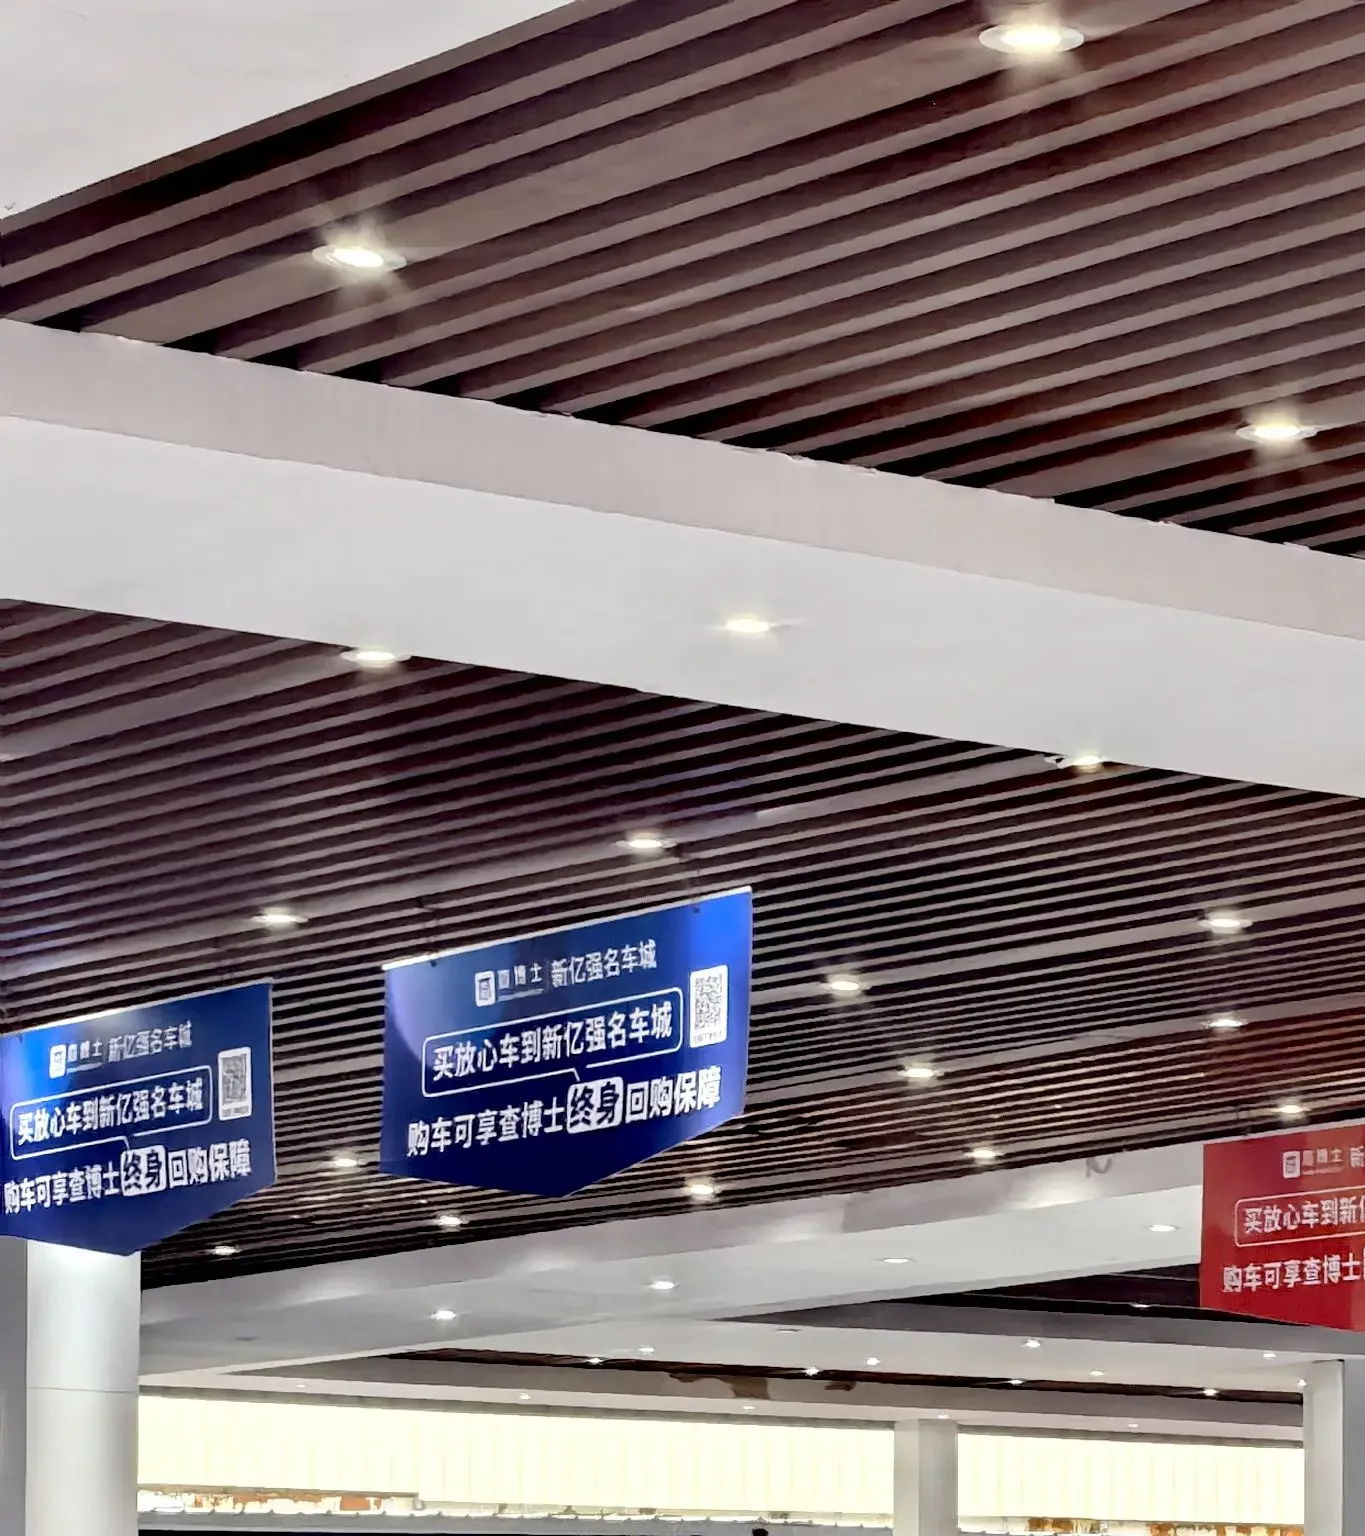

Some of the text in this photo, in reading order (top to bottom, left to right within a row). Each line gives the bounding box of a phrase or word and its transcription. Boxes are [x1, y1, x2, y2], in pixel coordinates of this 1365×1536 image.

[551, 939, 658, 988] 新亿强名车城
[432, 1001, 673, 1083] 买放心车到新亿强名车城
[17, 1077, 204, 1145] 买放心车到新亿强名车城
[406, 1065, 722, 1158] 购车可享查博士终身回购保障
[4, 1138, 252, 1214] 购车可享查博士终身回购保障
